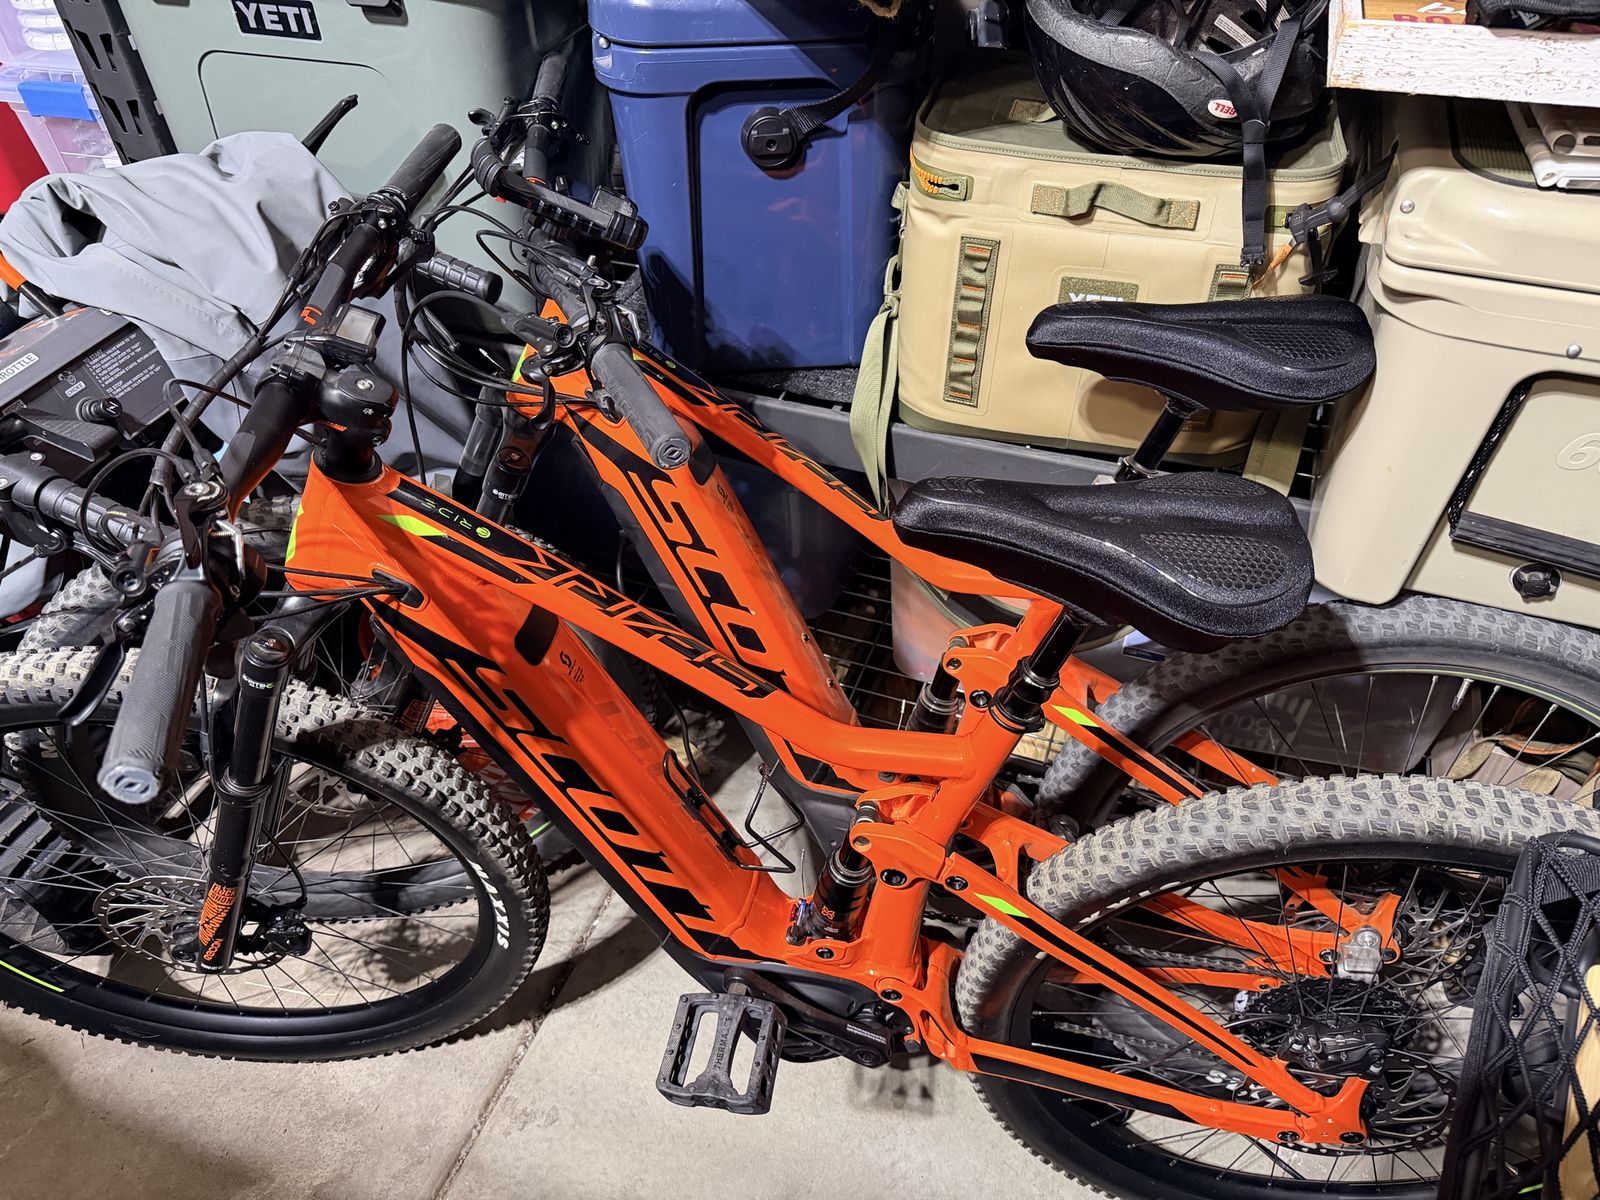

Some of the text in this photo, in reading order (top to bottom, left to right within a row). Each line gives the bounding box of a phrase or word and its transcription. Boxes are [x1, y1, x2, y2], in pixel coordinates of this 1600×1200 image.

[235, 1, 314, 34] YETI
[66, 382, 85, 396] CHOKE
[466, 858, 510, 950] MAXXIS
